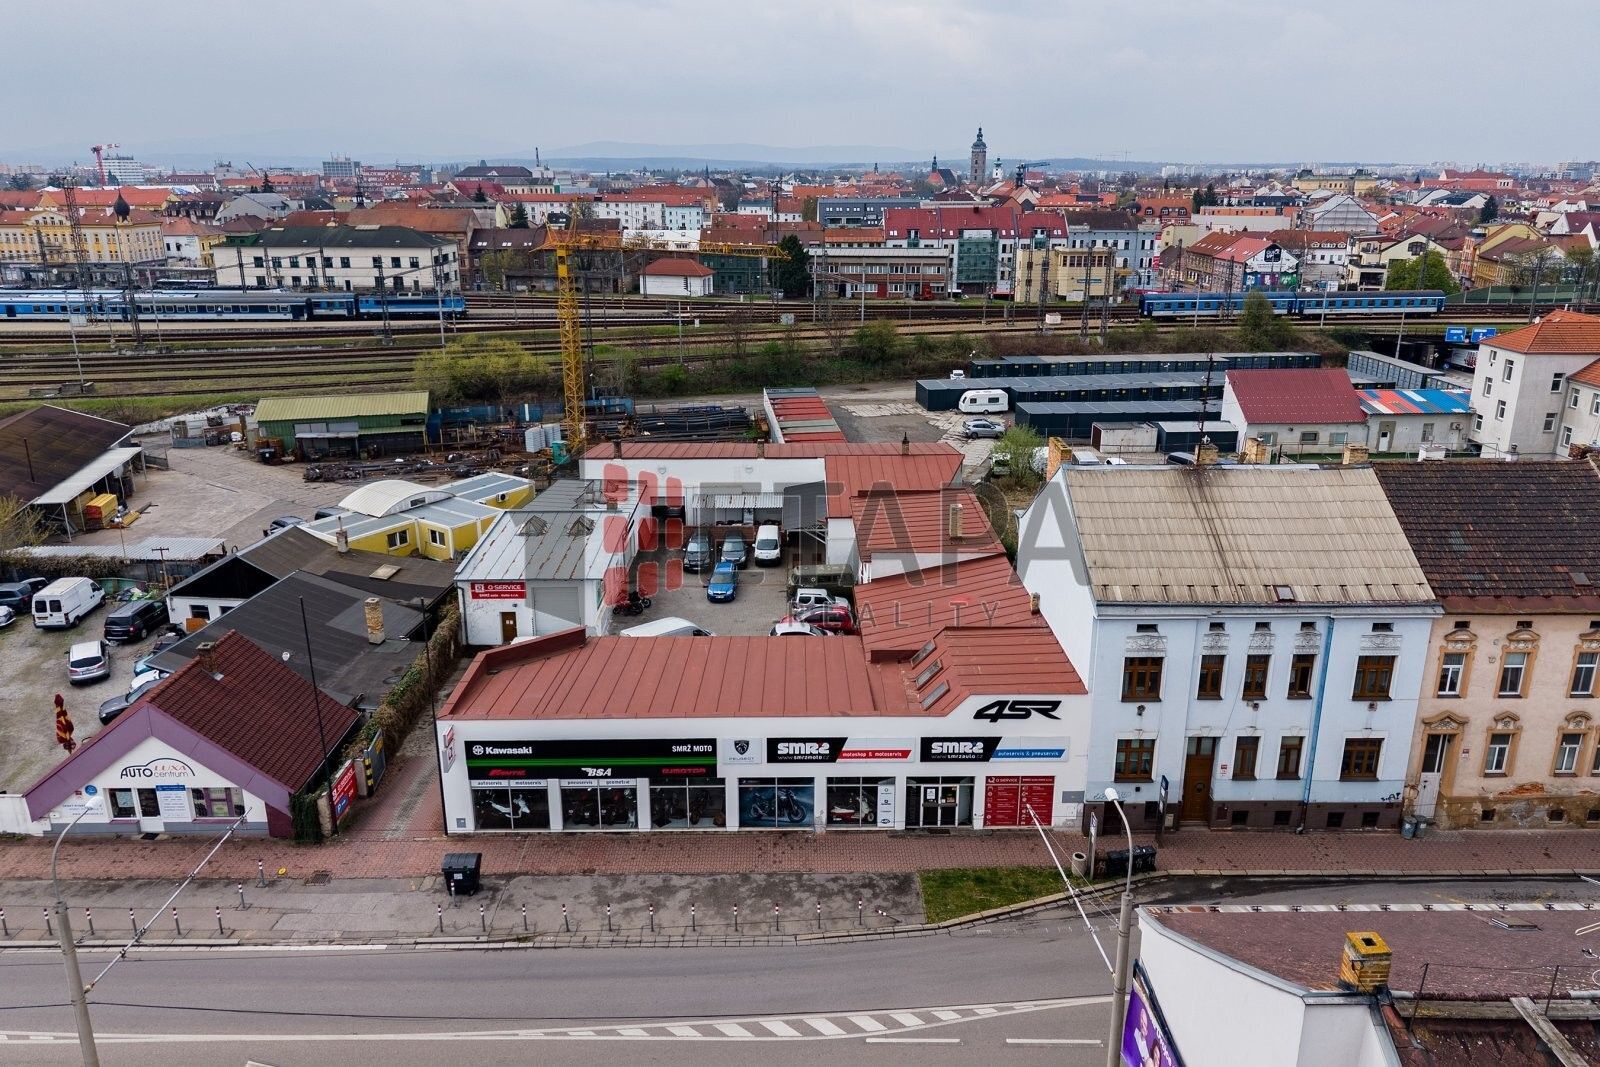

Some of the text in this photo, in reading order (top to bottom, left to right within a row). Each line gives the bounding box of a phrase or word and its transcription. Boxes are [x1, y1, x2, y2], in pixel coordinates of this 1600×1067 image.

[973, 699, 1062, 723] 4SR
[485, 746, 533, 755] Kawasaki
[671, 744, 692, 753] SMRŽ
[120, 768, 153, 779] AUTO
[581, 767, 612, 777] BSA
